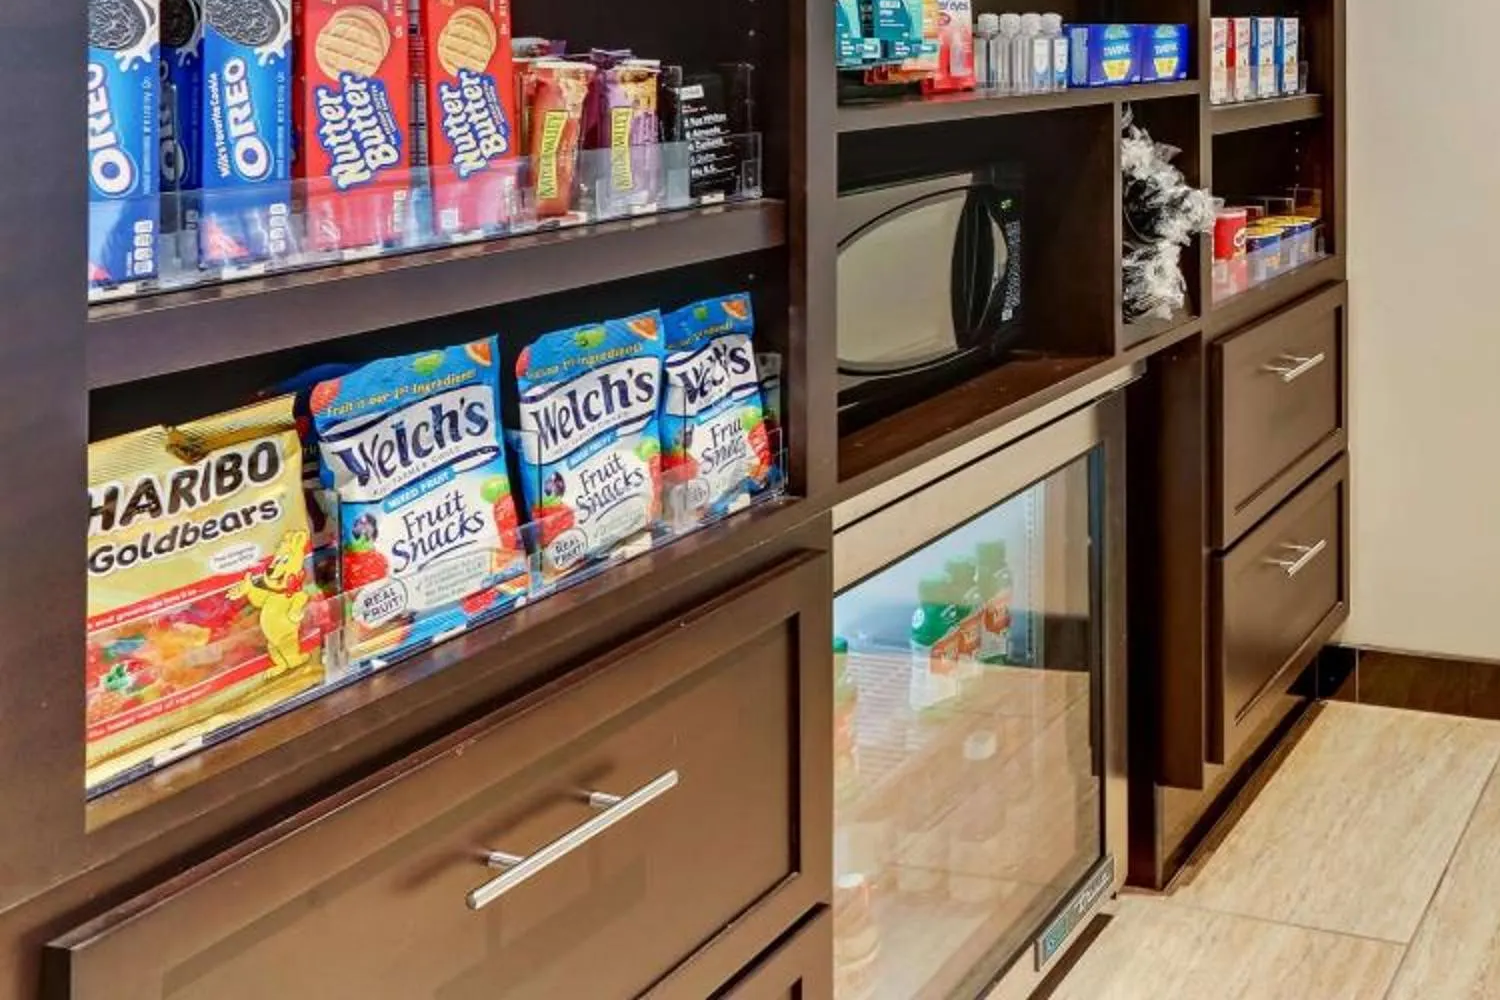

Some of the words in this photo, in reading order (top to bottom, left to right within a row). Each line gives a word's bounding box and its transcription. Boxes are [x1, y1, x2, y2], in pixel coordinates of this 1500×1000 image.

[87, 63, 132, 194] OREO
[224, 58, 267, 178] OREO
[317, 88, 372, 189] Nutter
[342, 74, 399, 171] Butter
[439, 84, 487, 177] Nutter
[460, 70, 507, 158] Butter
[331, 396, 489, 487] Welch's
[529, 367, 655, 451] Welch's
[86, 439, 282, 533] HARIBO
[402, 489, 467, 542] Fruit
[575, 467, 645, 525] Snacks
[578, 452, 625, 495] Fruit
[89, 498, 280, 574] Goldbears
[391, 508, 485, 574] Snacks
